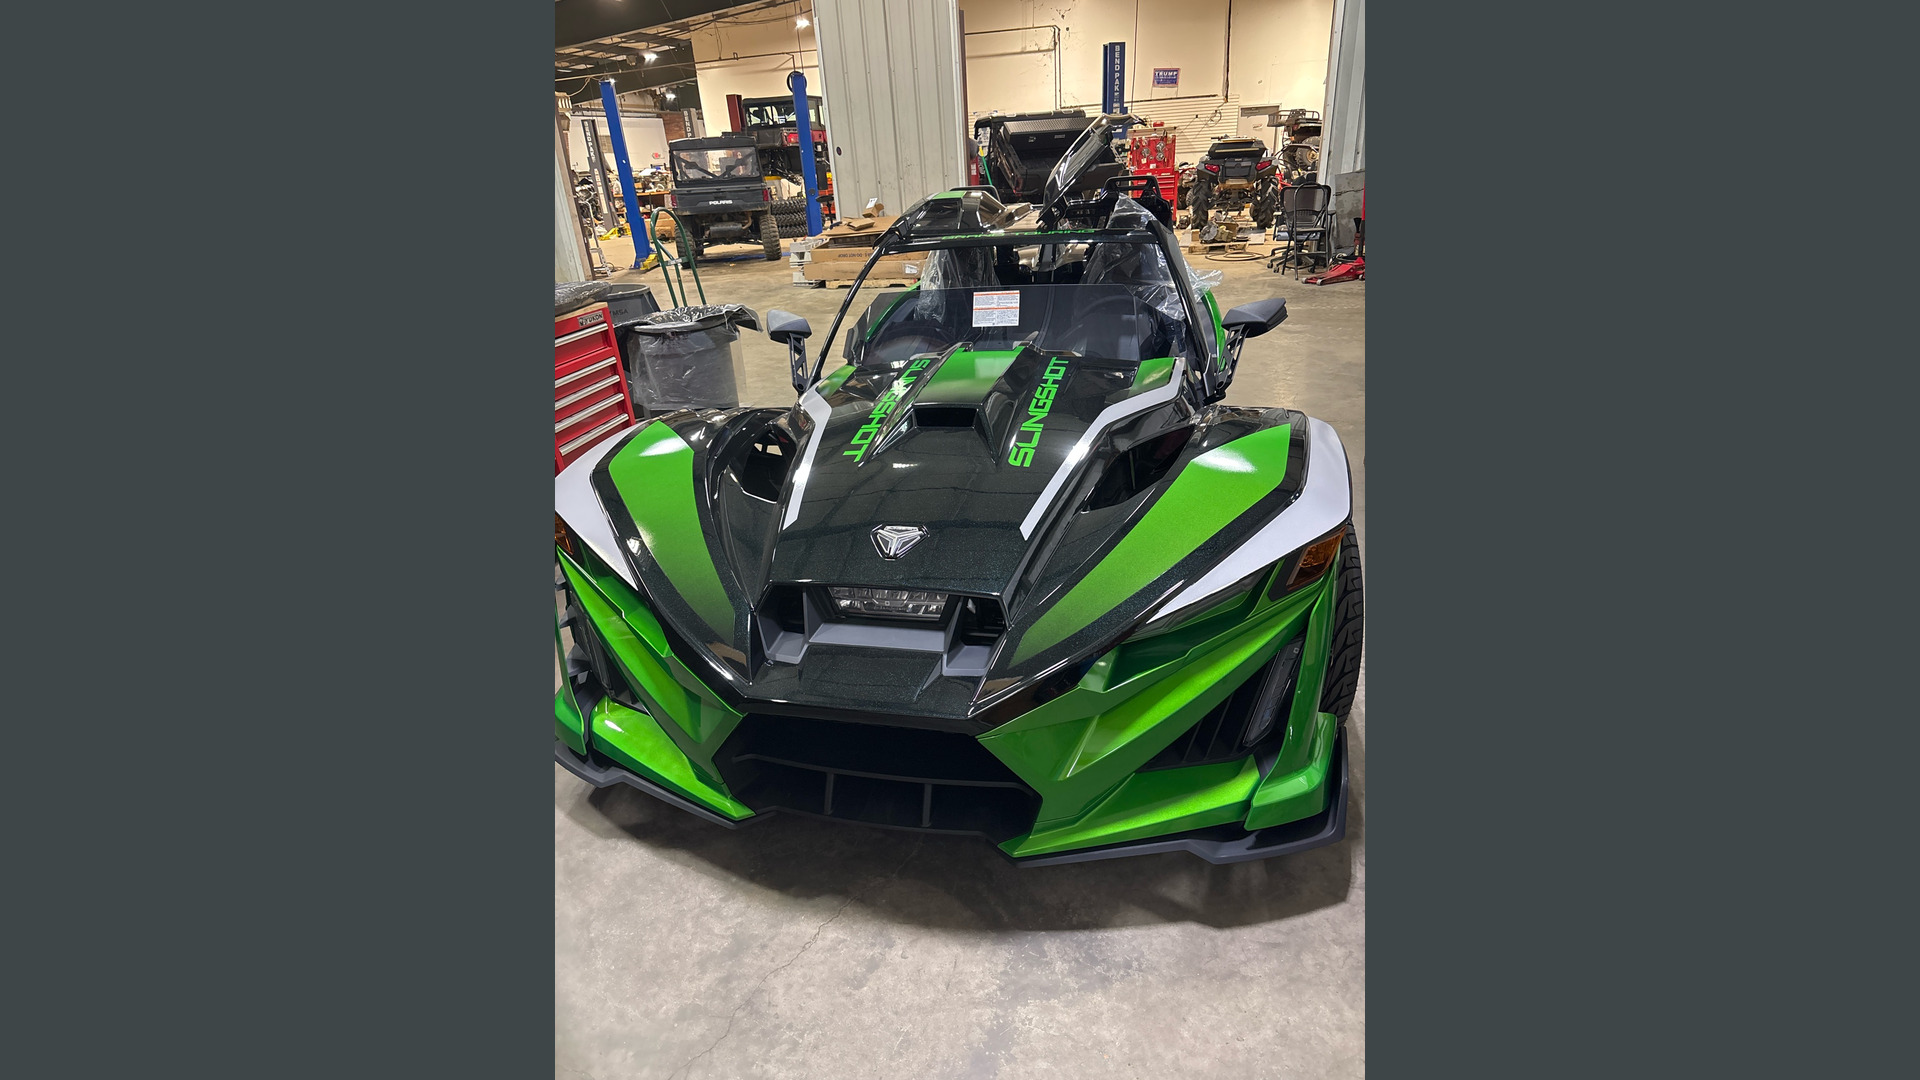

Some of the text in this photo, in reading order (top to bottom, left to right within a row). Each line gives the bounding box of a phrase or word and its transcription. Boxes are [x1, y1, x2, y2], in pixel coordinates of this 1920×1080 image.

[941, 228, 1095, 240] GRAND TOURING
[1008, 356, 1070, 468] SLINGSHOT
